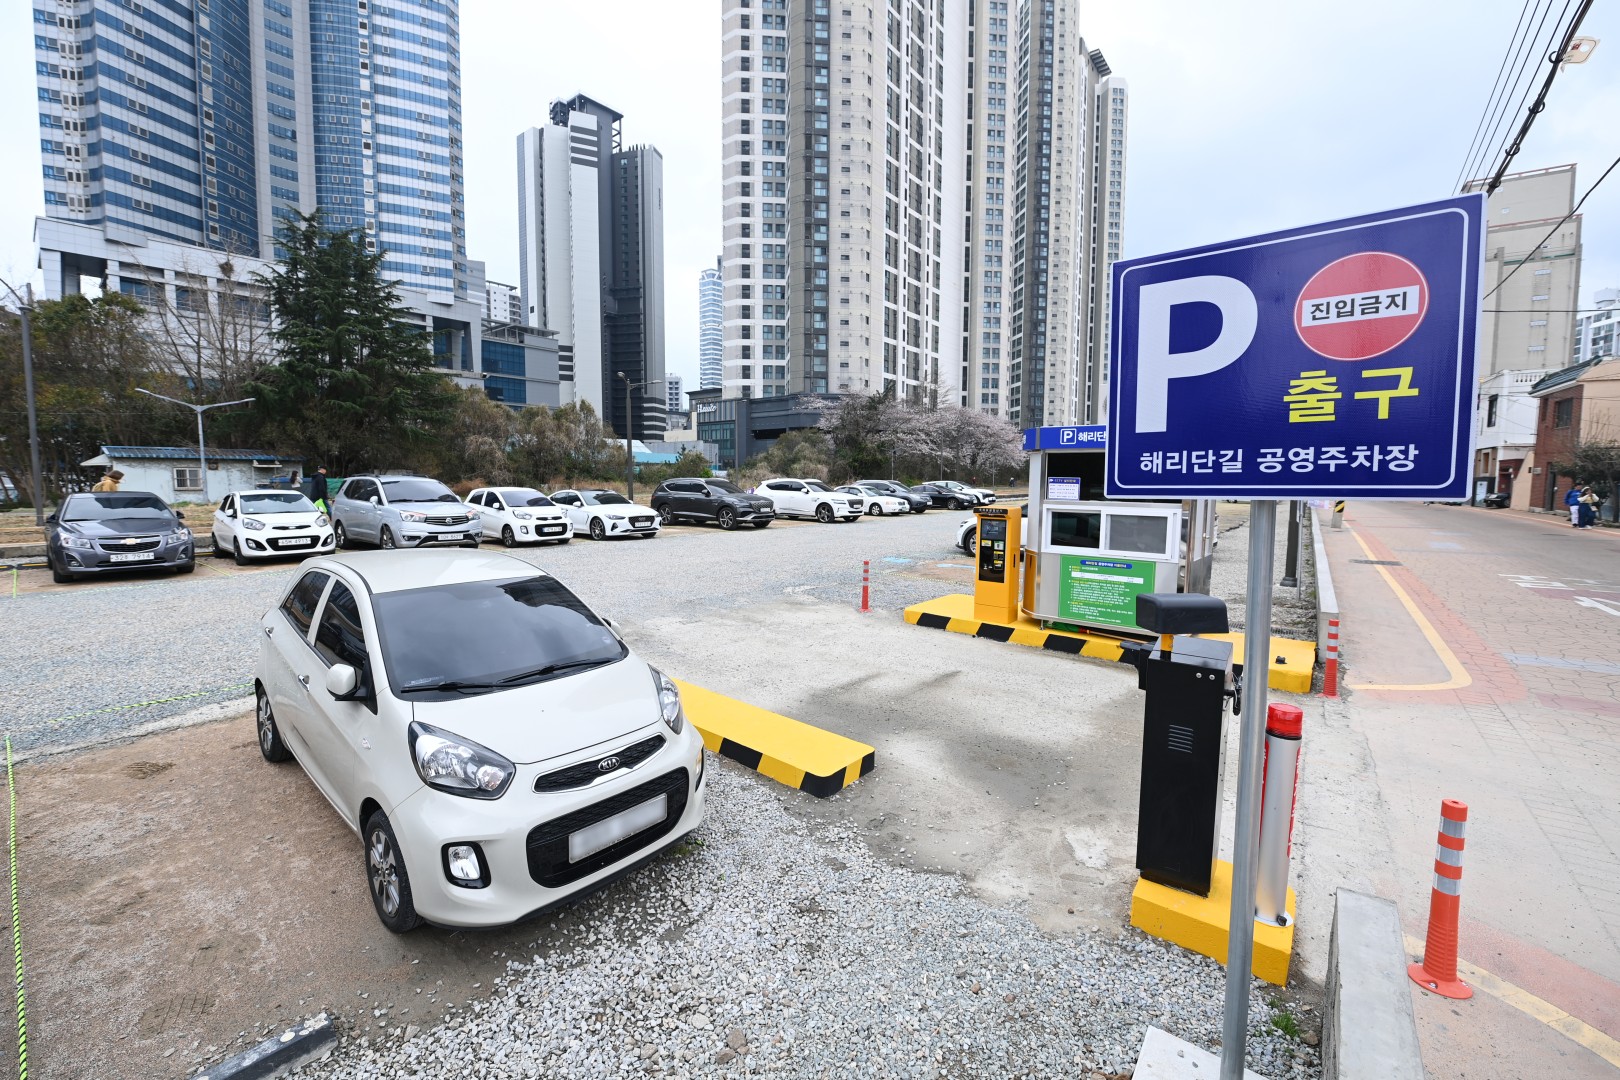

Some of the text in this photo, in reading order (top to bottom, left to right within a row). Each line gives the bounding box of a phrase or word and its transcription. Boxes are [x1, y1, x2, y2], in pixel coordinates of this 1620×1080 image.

[1310, 291, 1408, 321] 진입금지
[1135, 274, 1258, 434] P
[1063, 431, 1073, 442] P
[1140, 443, 1419, 474] 해리단길 공영주차장
[602, 758, 618, 770] KIA
